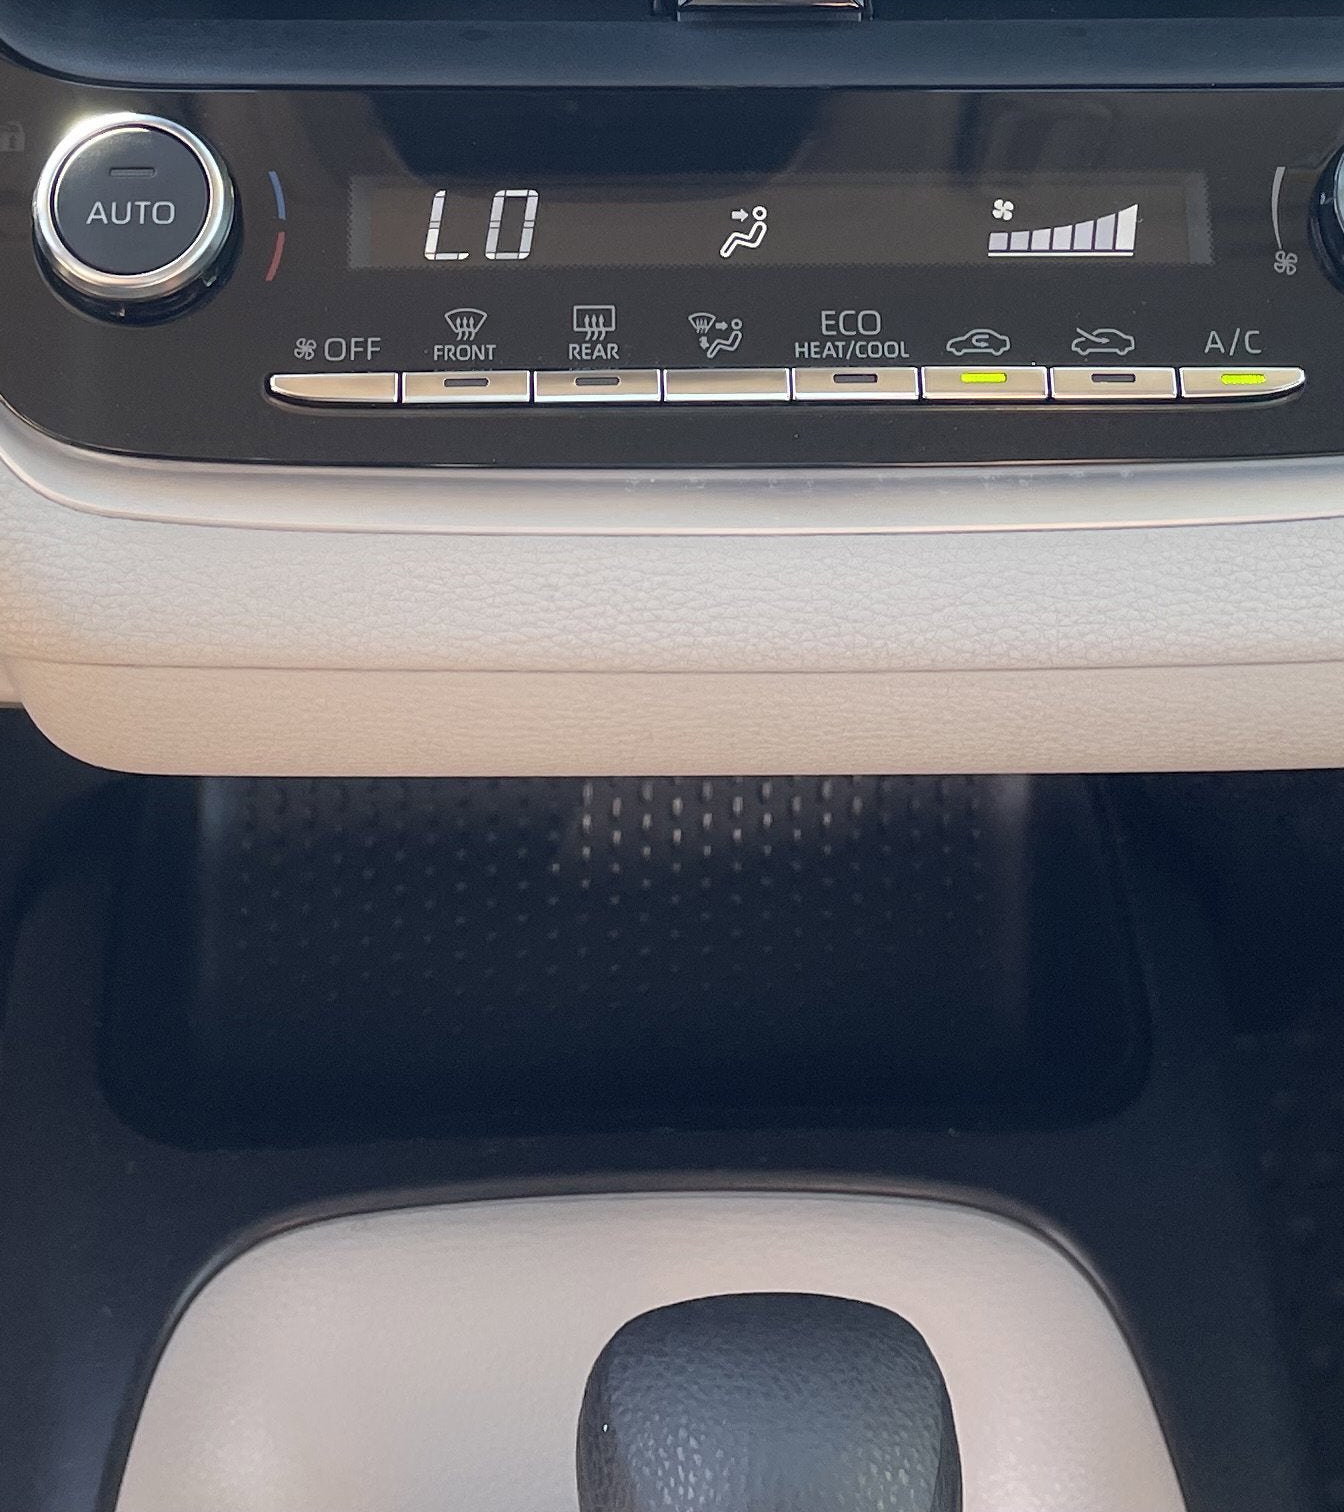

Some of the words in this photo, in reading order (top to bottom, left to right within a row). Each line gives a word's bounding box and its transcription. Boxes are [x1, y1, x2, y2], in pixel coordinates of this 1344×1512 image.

[86, 201, 175, 224] AUTO
[425, 189, 539, 260] LO
[821, 310, 881, 335] ECO
[324, 337, 381, 361] OFF
[434, 344, 496, 360] FRONT
[569, 343, 619, 360] REAR
[795, 341, 910, 360] HEAT/COOL
[1203, 329, 1262, 355] A/C
